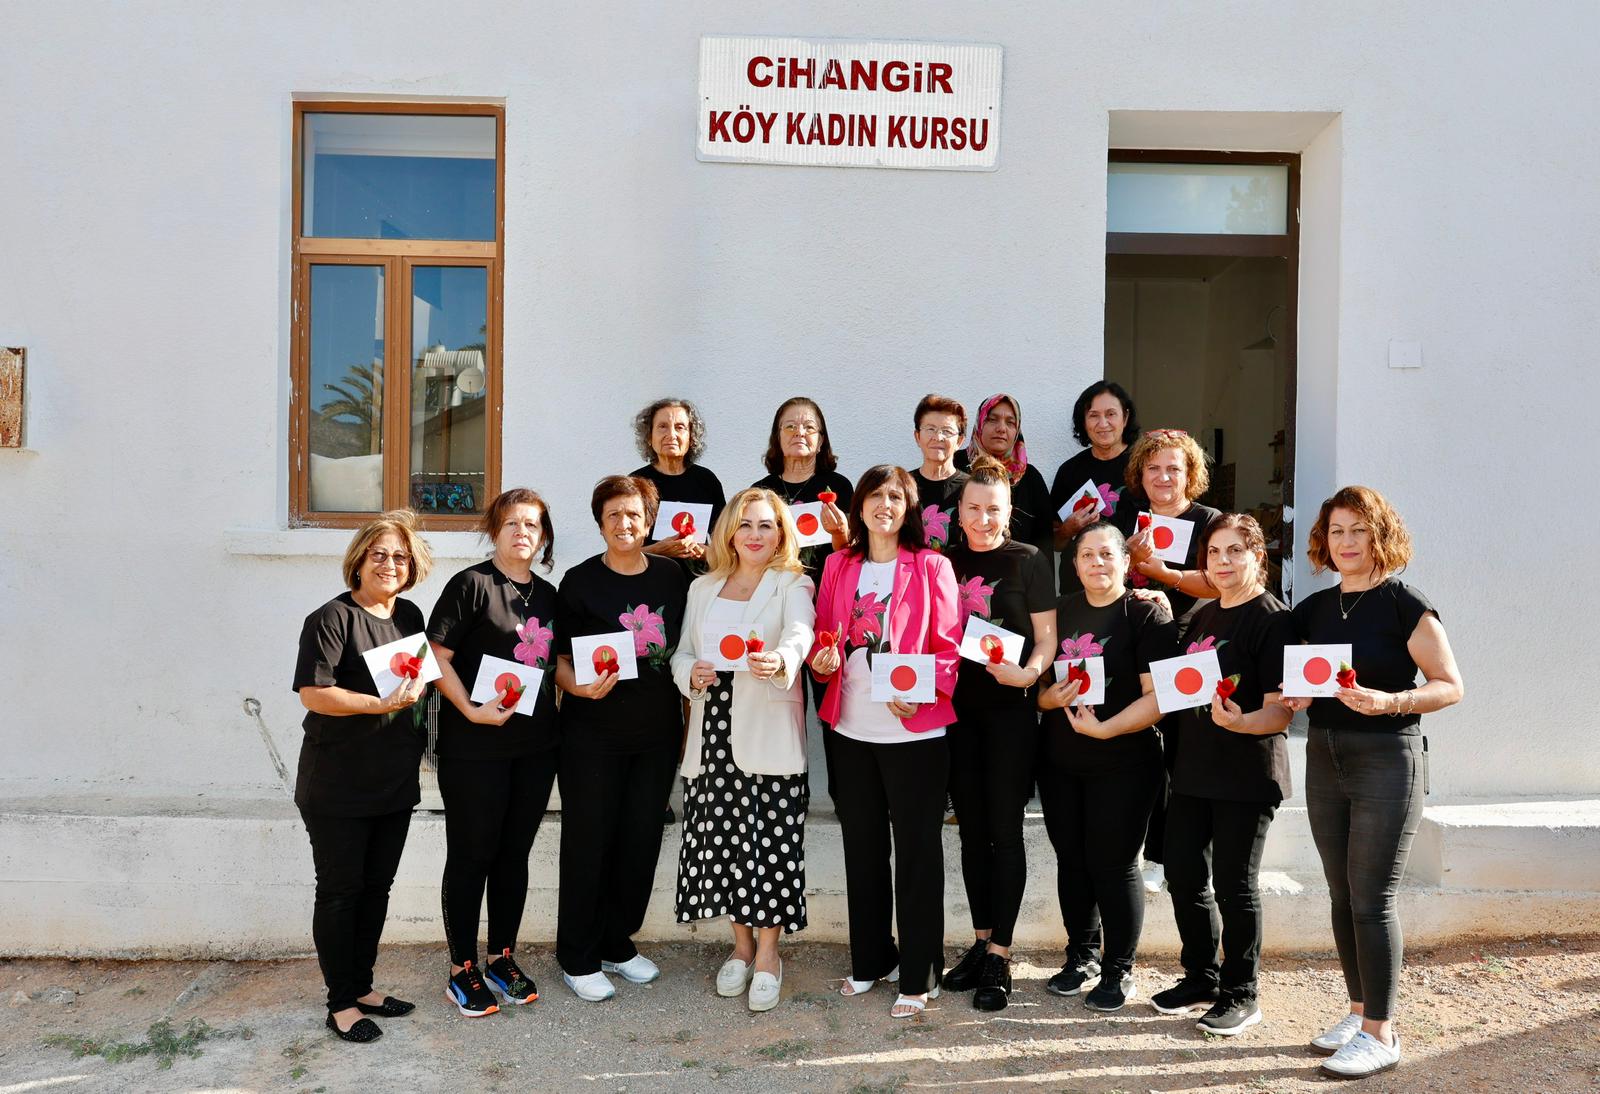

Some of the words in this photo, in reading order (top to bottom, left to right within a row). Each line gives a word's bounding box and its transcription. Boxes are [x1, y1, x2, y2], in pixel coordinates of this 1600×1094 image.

[708, 104, 778, 144] KÖY
[786, 112, 877, 147] KADIN
[887, 115, 989, 152] KURSU
